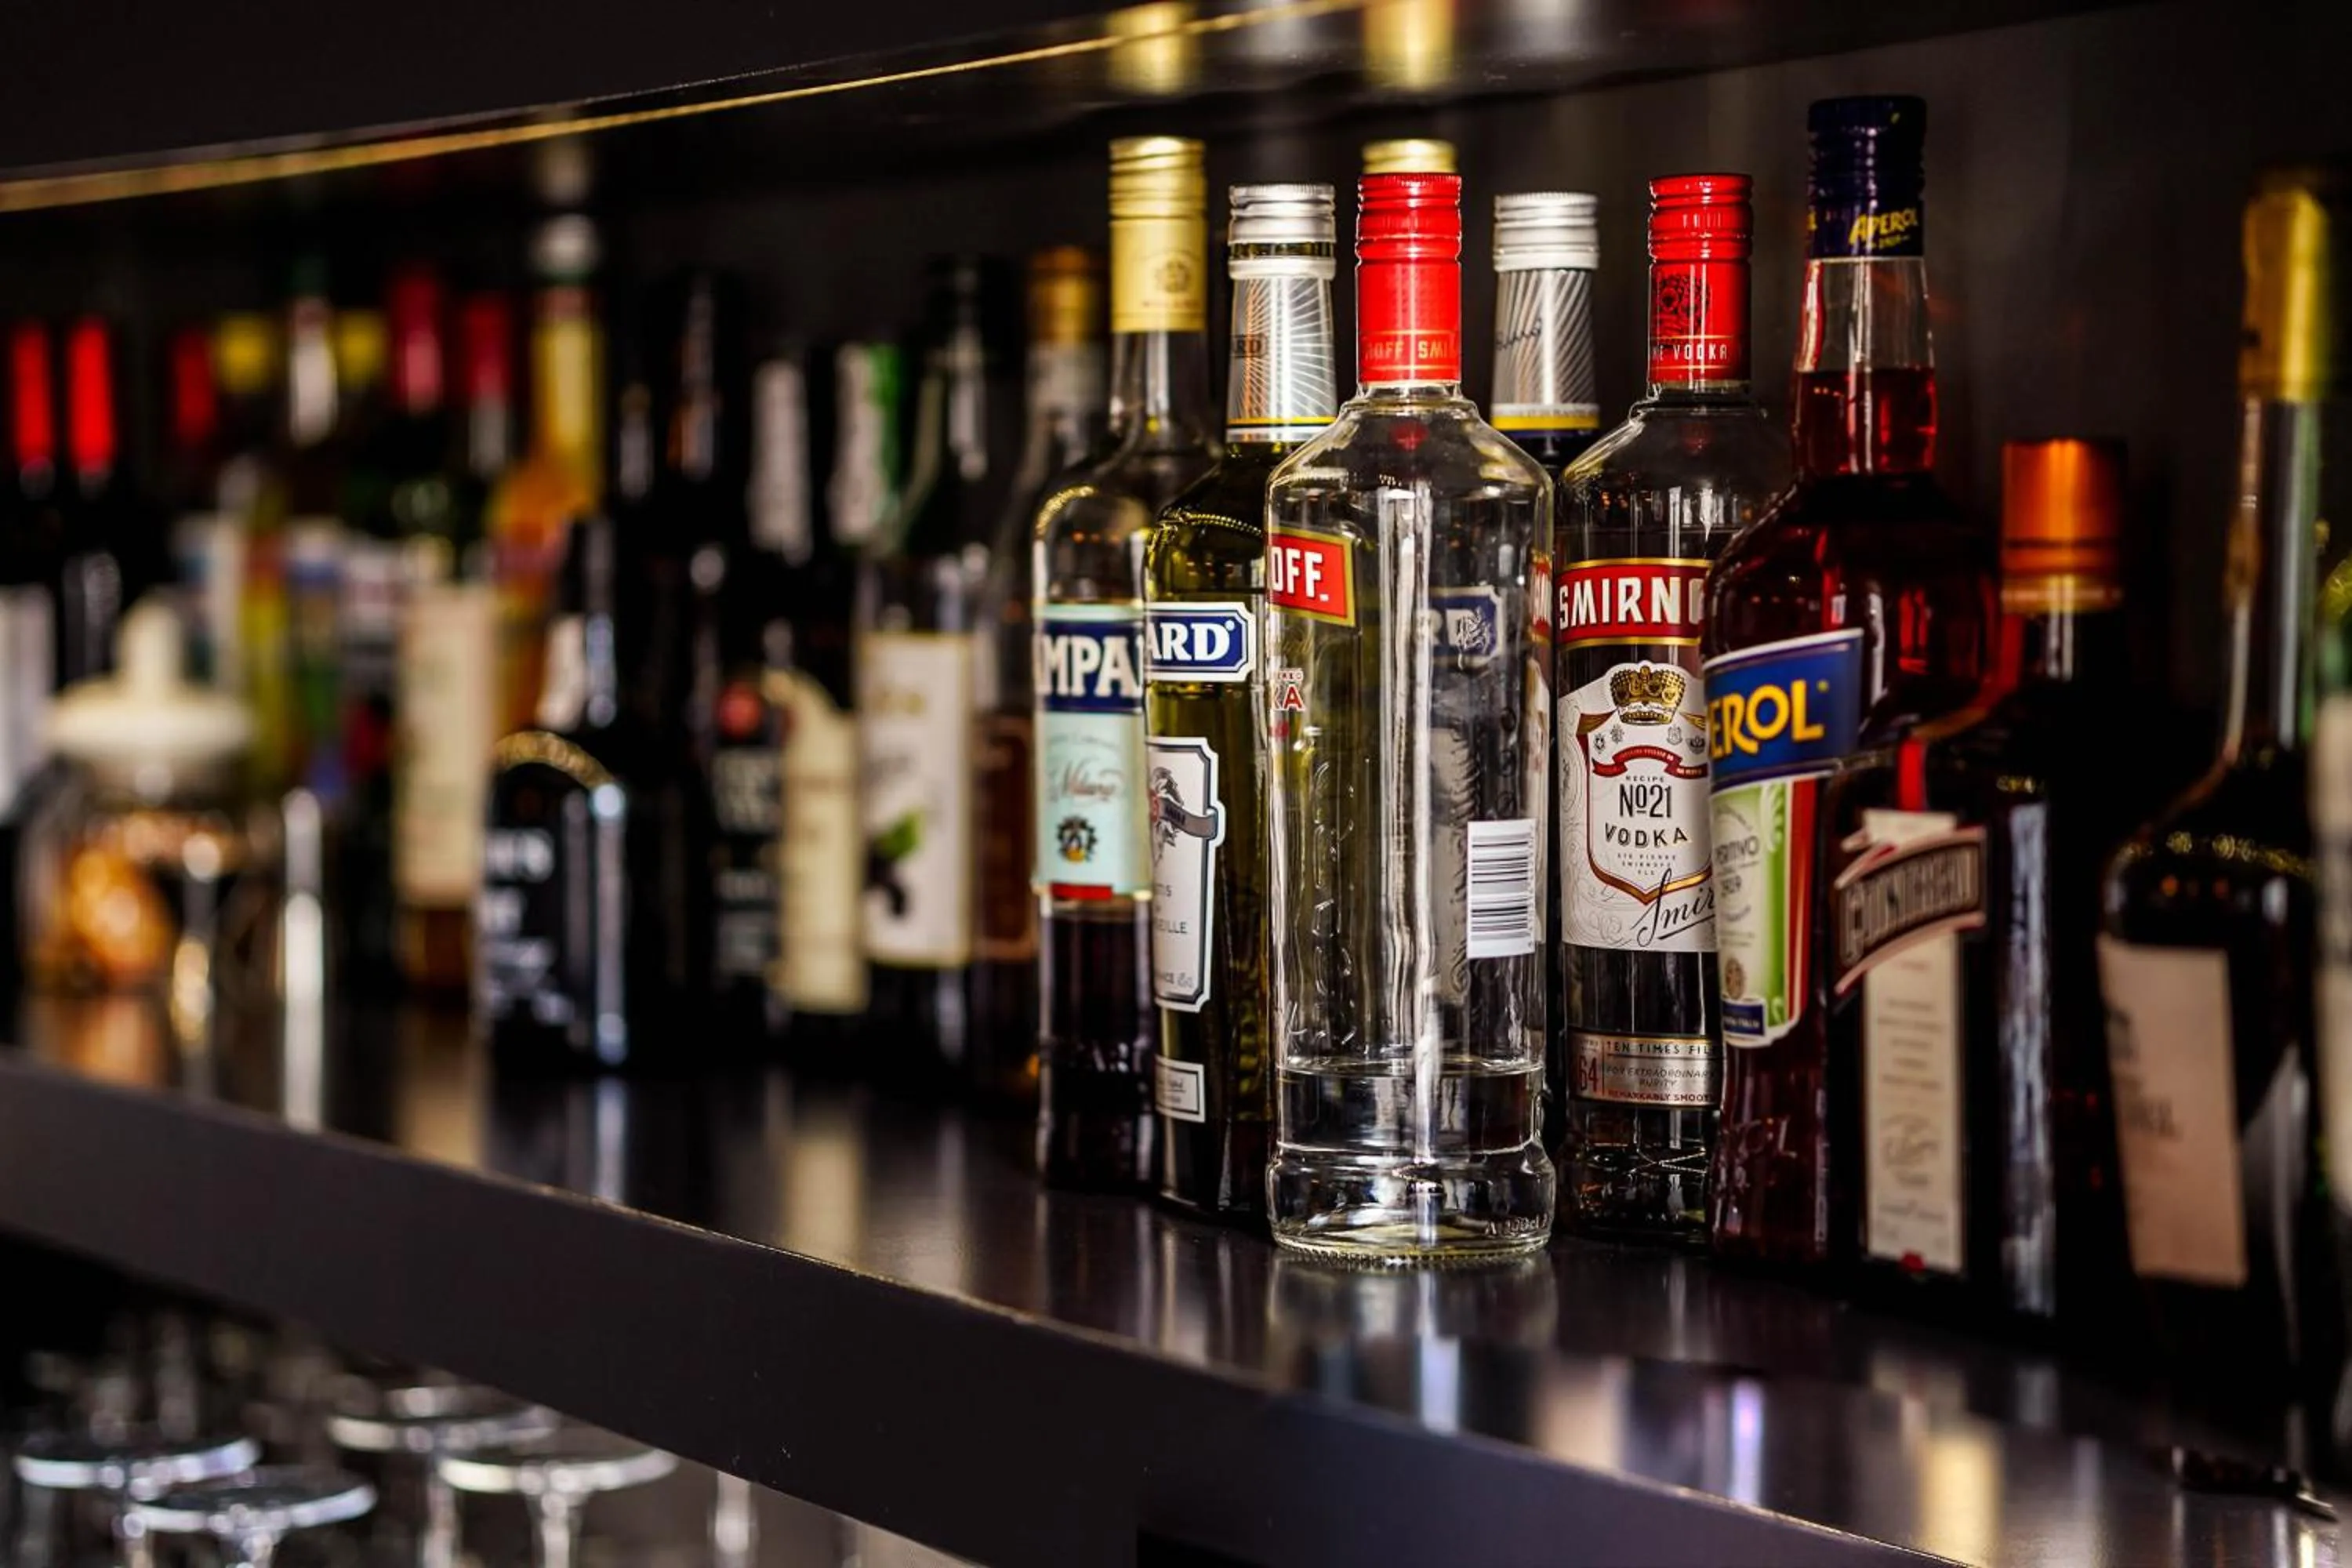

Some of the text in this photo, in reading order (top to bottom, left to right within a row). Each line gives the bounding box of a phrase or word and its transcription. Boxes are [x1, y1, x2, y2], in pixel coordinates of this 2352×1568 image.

[1673, 343, 1727, 361] VODKA
[1035, 634, 1144, 697] MPA
[1606, 823, 1688, 848] VODKA
[1639, 1044, 1680, 1054] TIMES
